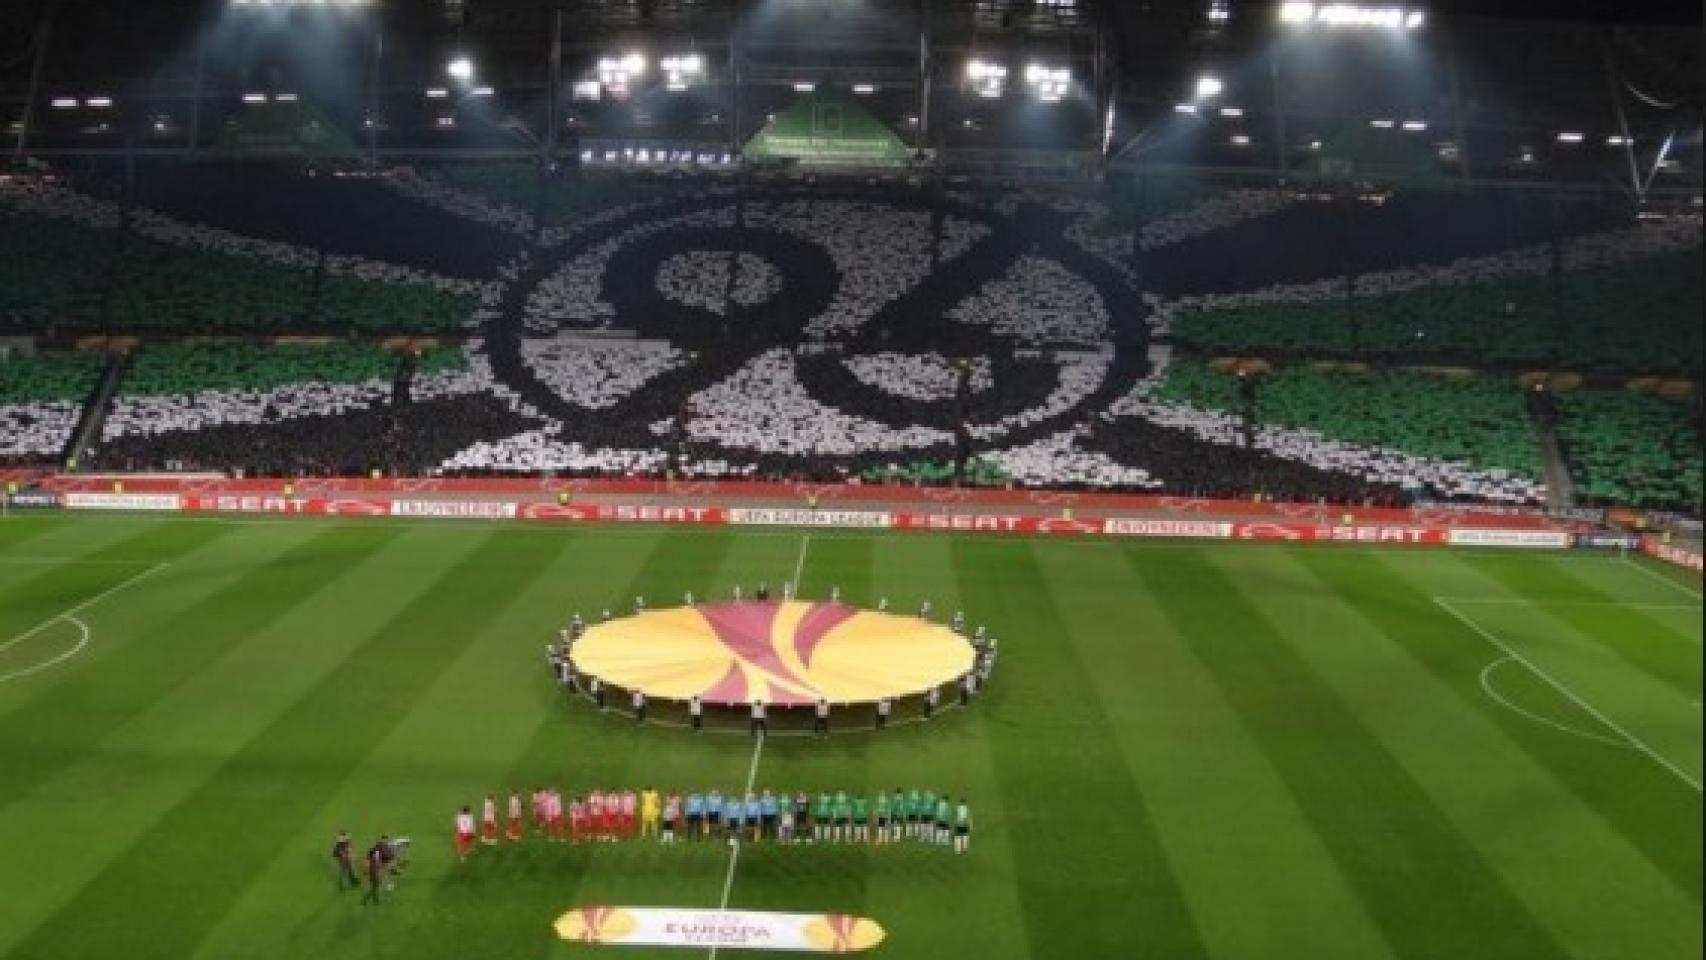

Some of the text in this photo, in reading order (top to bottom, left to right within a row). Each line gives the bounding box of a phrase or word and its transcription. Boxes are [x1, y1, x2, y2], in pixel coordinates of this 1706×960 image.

[598, 200, 1065, 435] 96
[217, 496, 308, 512] SEAT
[617, 505, 710, 521] SEAT
[929, 515, 1022, 530] SEAT
[1332, 526, 1427, 542] SEAT
[665, 923, 771, 937] EUROPA
